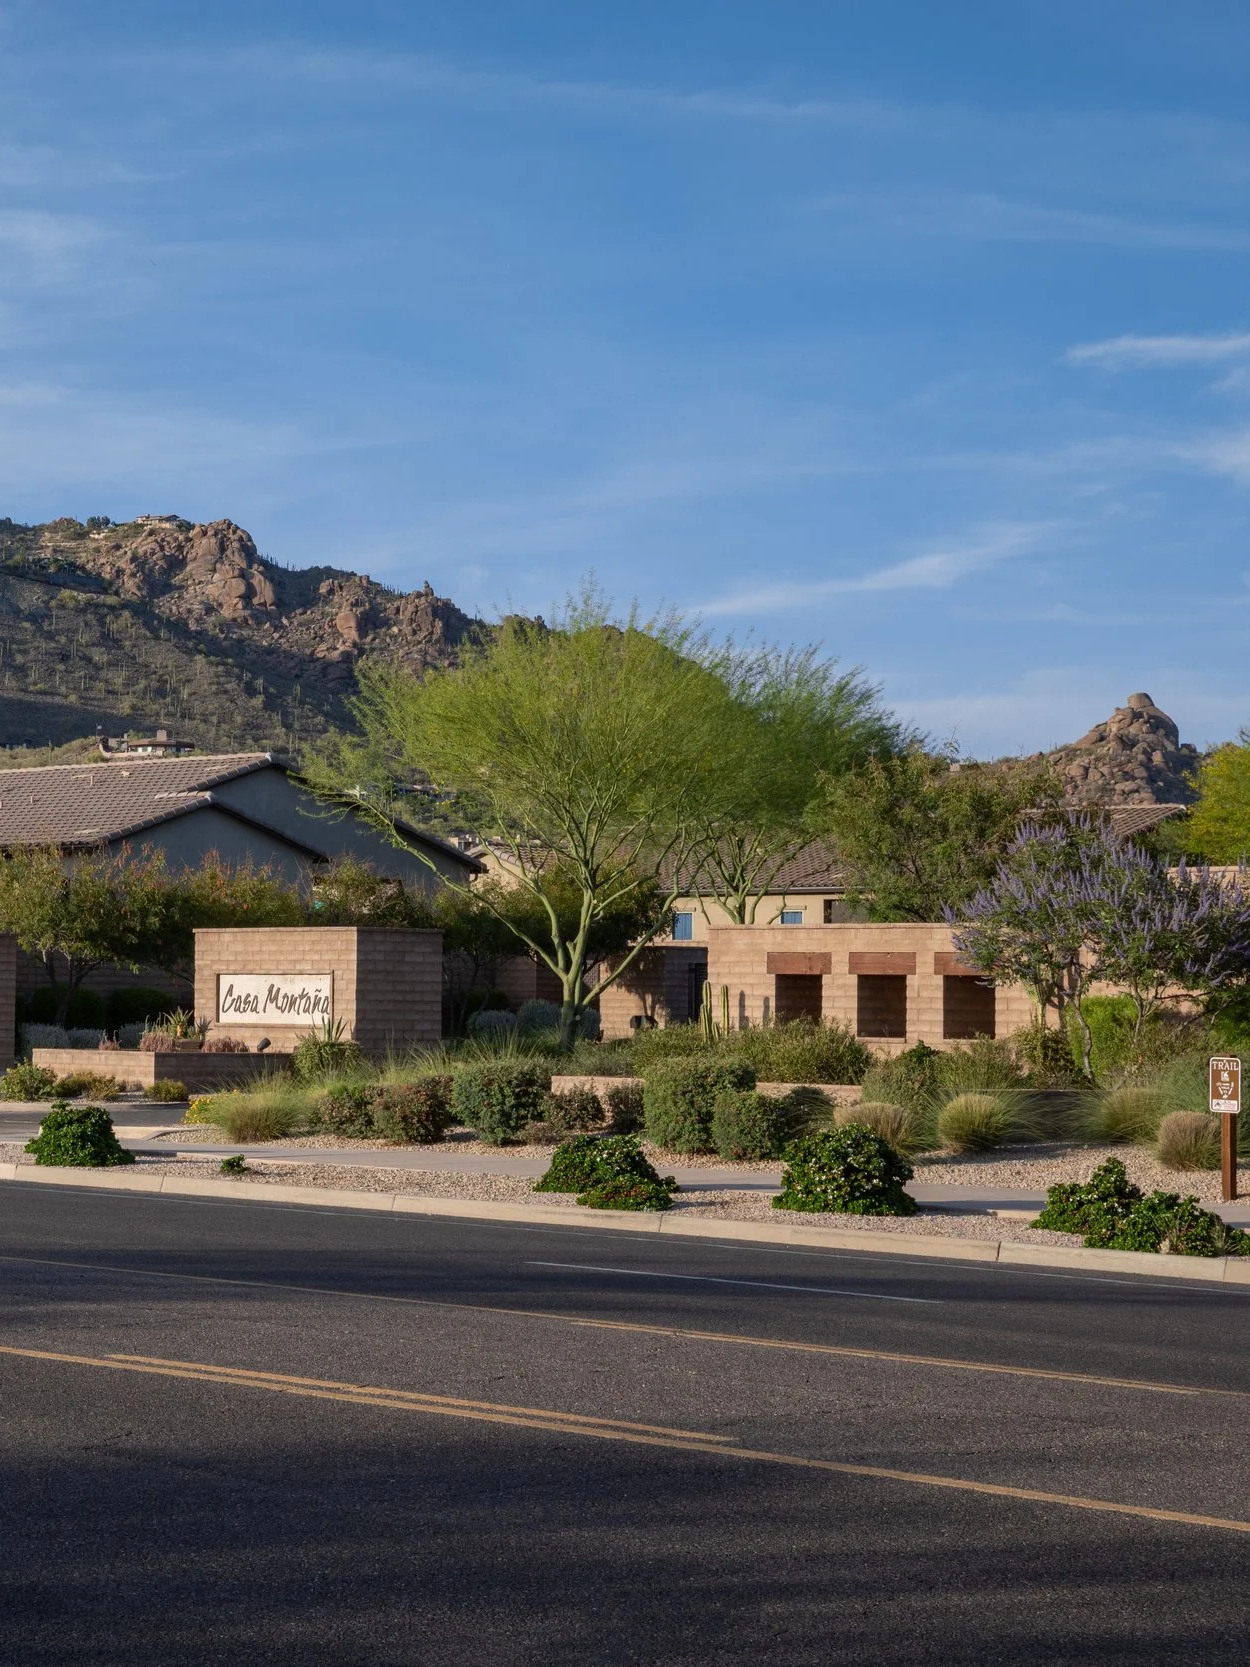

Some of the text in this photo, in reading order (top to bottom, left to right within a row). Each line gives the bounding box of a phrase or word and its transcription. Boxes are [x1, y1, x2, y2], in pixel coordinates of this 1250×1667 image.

[222, 984, 330, 1016] Casa Montaña
[1212, 1061, 1239, 1071] TRAIL
